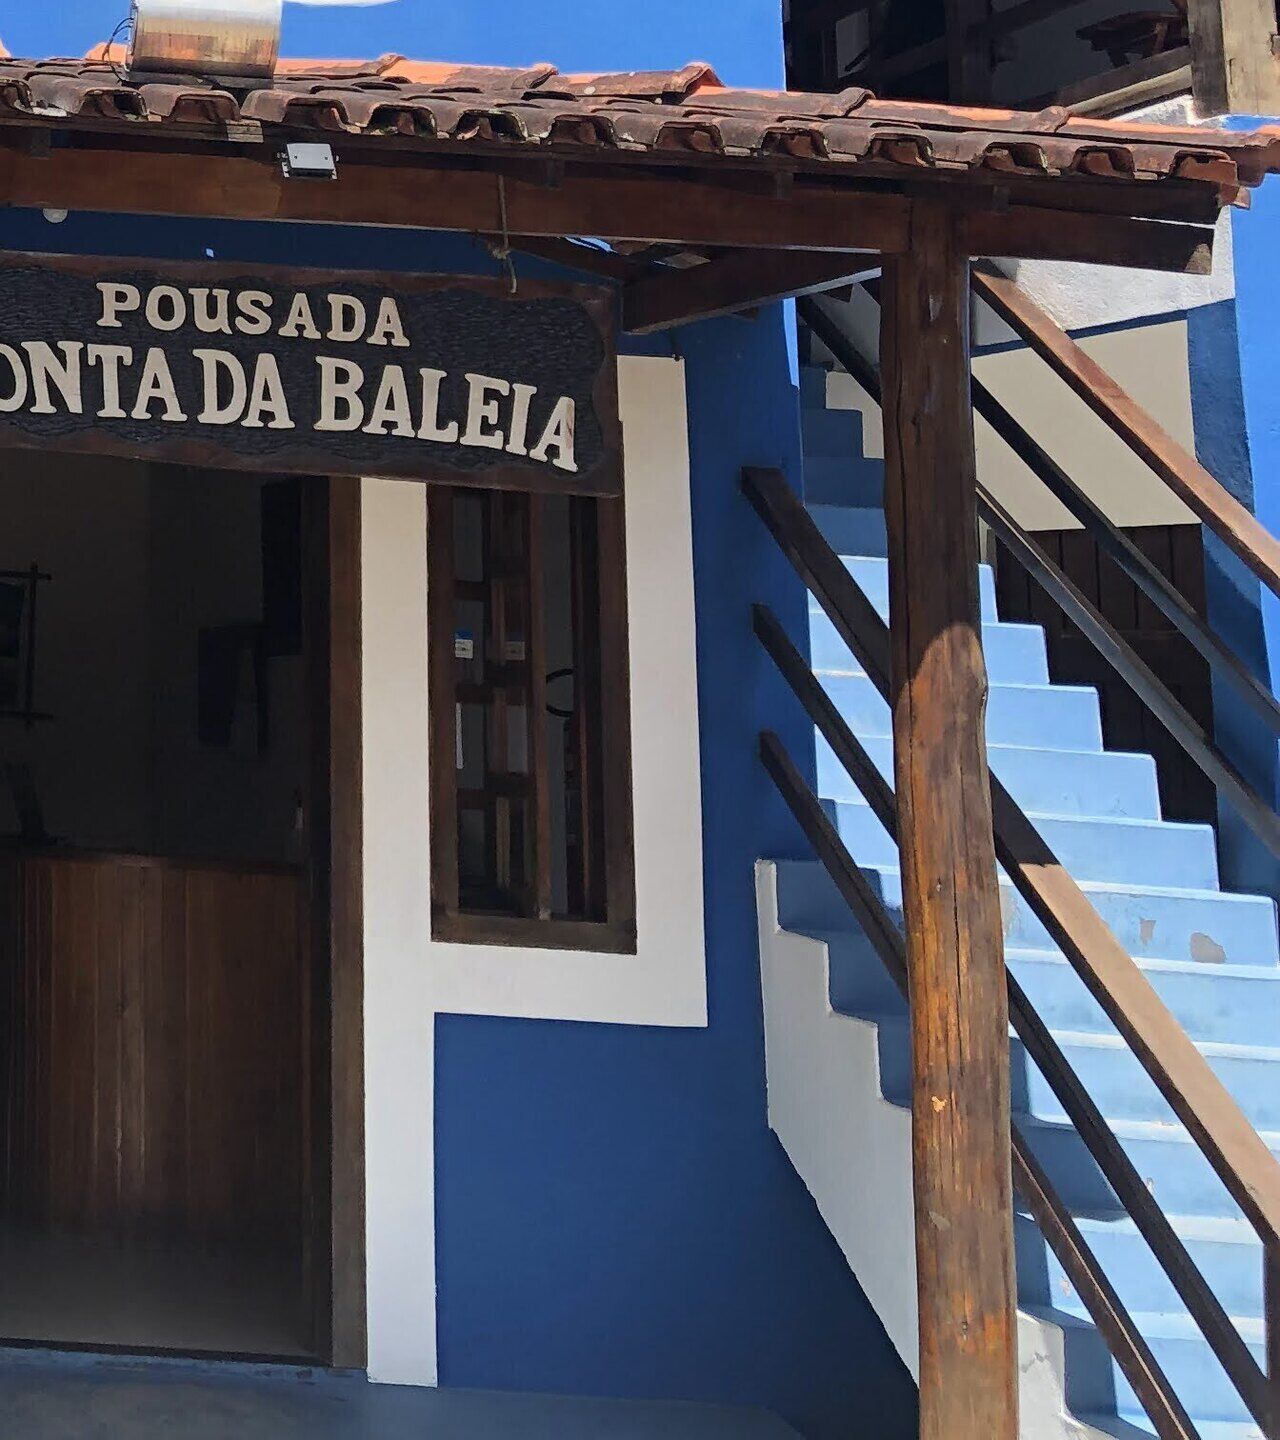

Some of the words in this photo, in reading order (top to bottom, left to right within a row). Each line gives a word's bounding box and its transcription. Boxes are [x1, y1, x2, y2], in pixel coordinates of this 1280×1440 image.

[96, 282, 410, 348] POUSADA
[191, 347, 296, 431] DA
[312, 355, 580, 473] BALEIA
